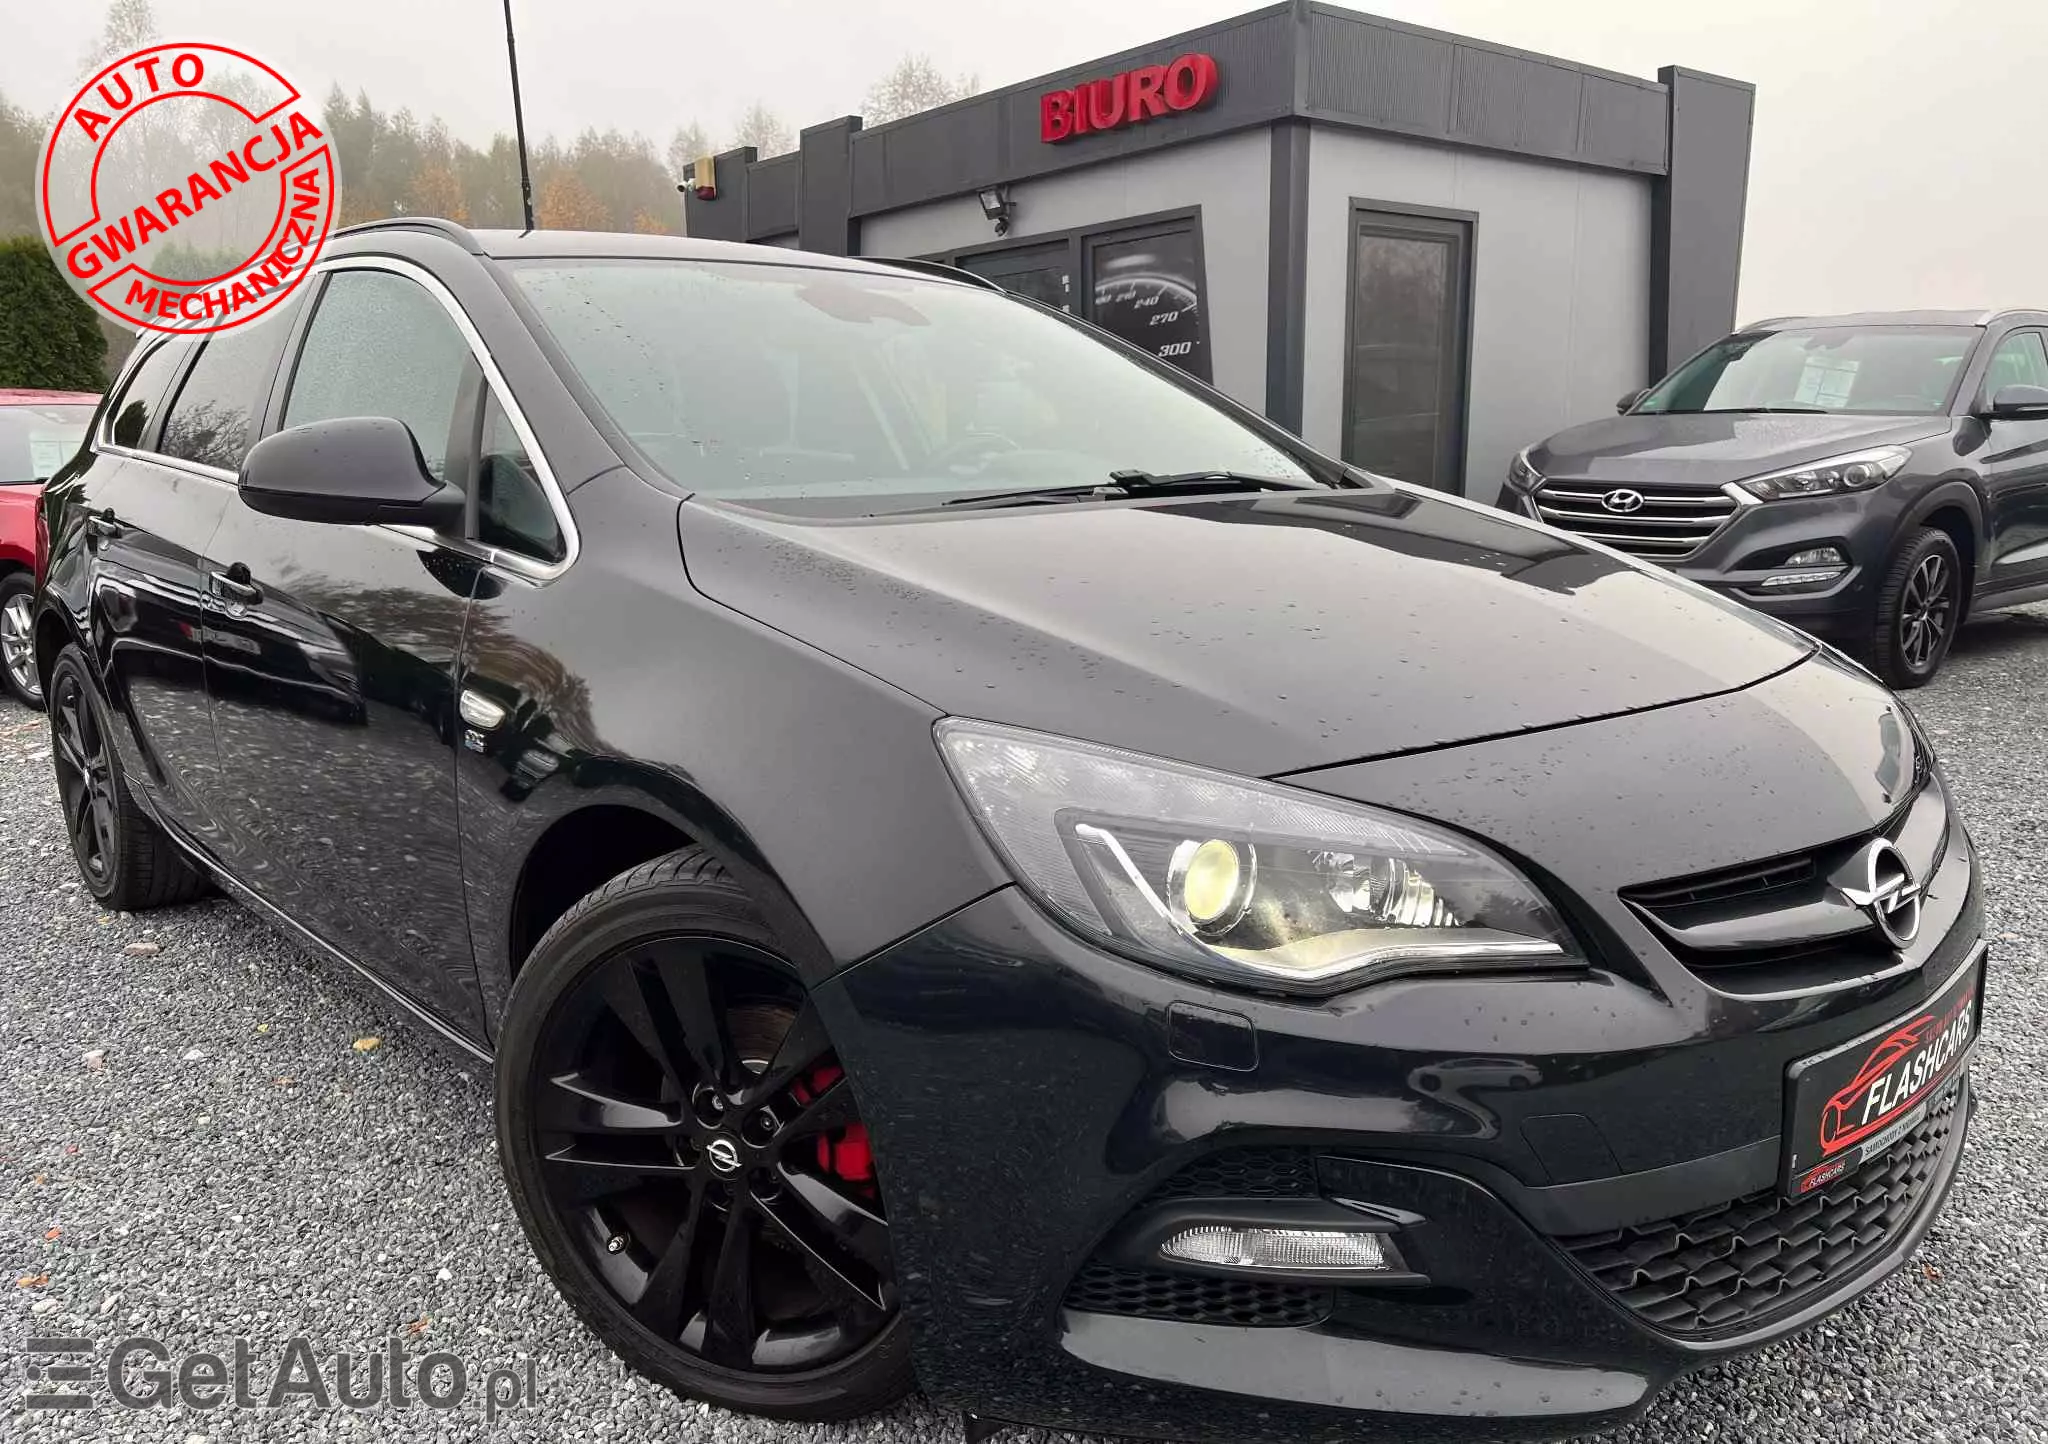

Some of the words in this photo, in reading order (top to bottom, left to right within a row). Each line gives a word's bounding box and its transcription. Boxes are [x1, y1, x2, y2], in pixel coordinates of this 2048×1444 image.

[1041, 53, 1218, 143] BIURO
[1149, 311, 1179, 326] 270
[1158, 341, 1192, 357] 300
[1861, 999, 1972, 1125] FLASHCARS
